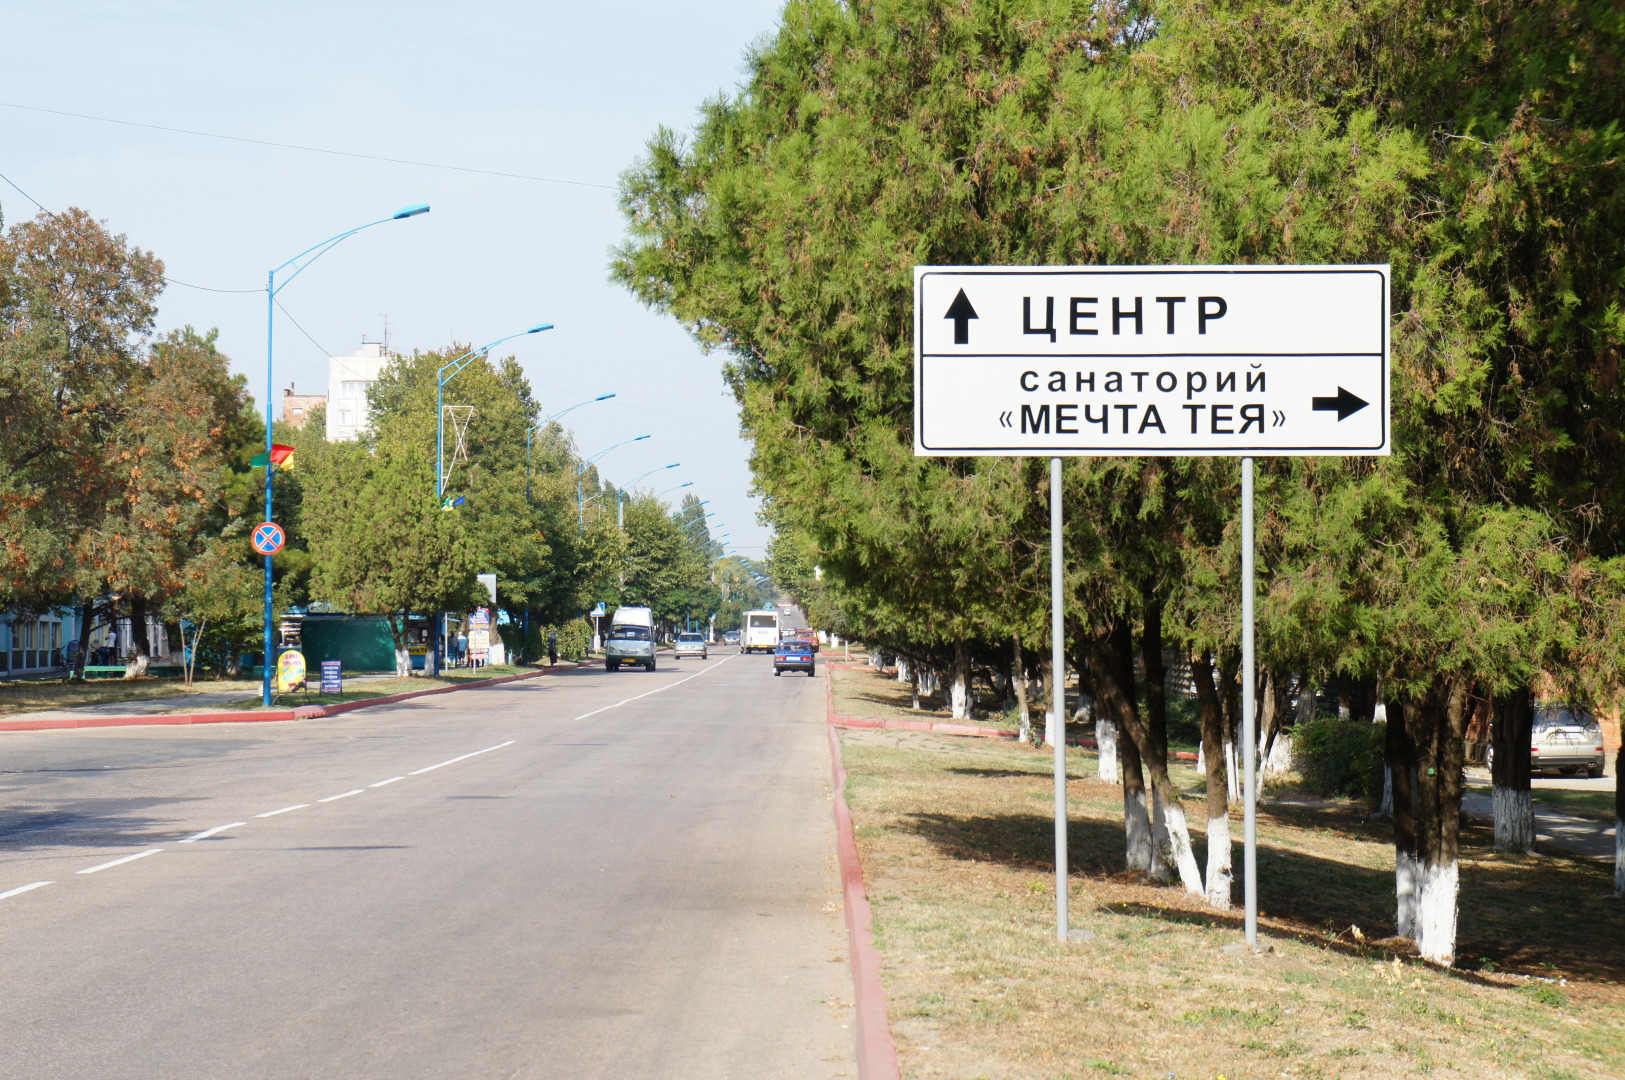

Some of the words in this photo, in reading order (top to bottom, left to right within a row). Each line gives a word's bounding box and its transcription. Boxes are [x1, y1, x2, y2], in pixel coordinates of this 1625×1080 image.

[1022, 296, 1228, 343] ЦЕНТР
[1019, 363, 1266, 400] санаторий
[999, 403, 1167, 435] «МЕЧТА
[1182, 403, 1286, 435] ТЕЯ»
